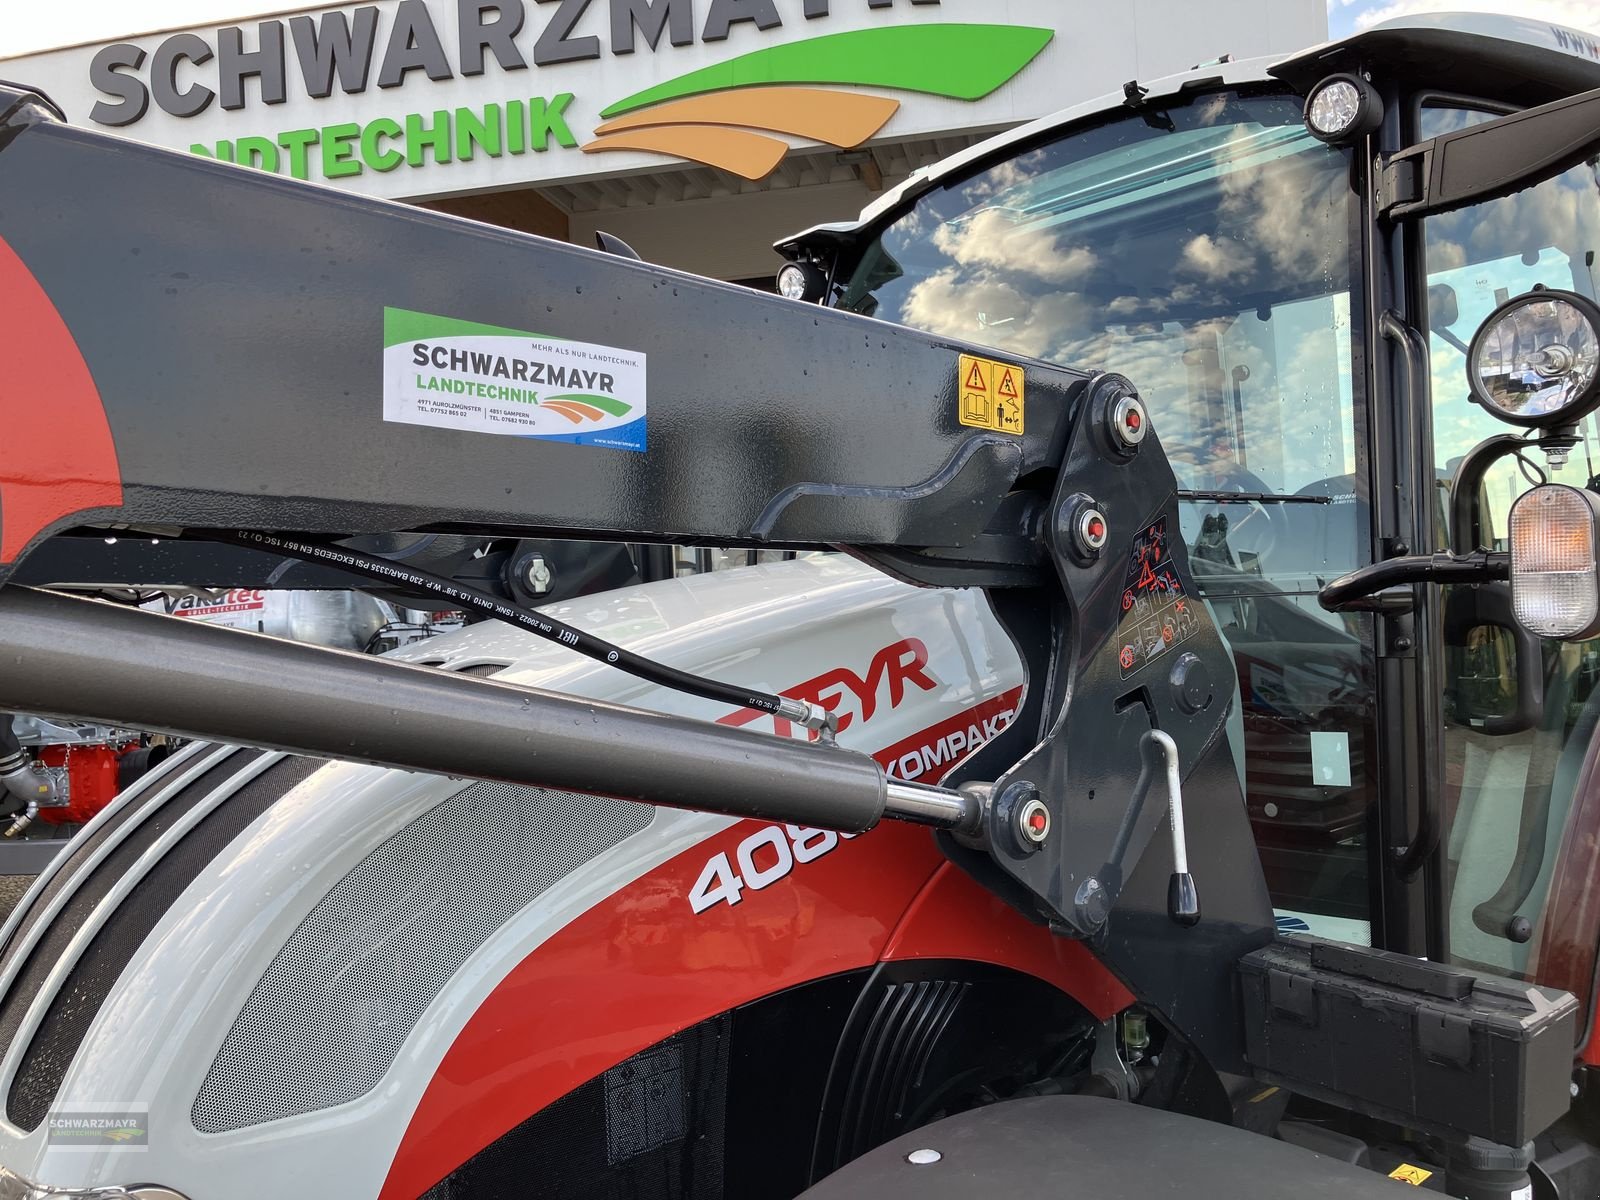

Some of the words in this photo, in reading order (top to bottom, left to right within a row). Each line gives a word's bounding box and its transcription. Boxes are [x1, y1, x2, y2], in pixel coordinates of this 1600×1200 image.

[531, 343, 553, 353] MEHR
[555, 347, 569, 355] ALS
[571, 350, 587, 359] NUR
[589, 353, 639, 367] LANDTECHNIK.
[412, 343, 614, 393] SCHWARZMAYR
[416, 374, 539, 405] LANDTECHNIK
[417, 405, 430, 413] TEL.
[503, 410, 530, 419] GAMPERN
[489, 414, 500, 422] TEL.
[283, 541, 299, 551] 857
[299, 544, 313, 554] EN
[314, 547, 354, 565] EXCEEDS
[355, 559, 370, 569] PSI
[371, 563, 409, 581] BAR/3335
[409, 575, 424, 585] 230
[426, 580, 441, 592] W.P.
[473, 597, 493, 609] DN10
[496, 605, 514, 617] 1SNK
[519, 614, 540, 627] 20022
[539, 622, 552, 633] DIN
[556, 629, 579, 646] HBT
[687, 824, 858, 915] 408
